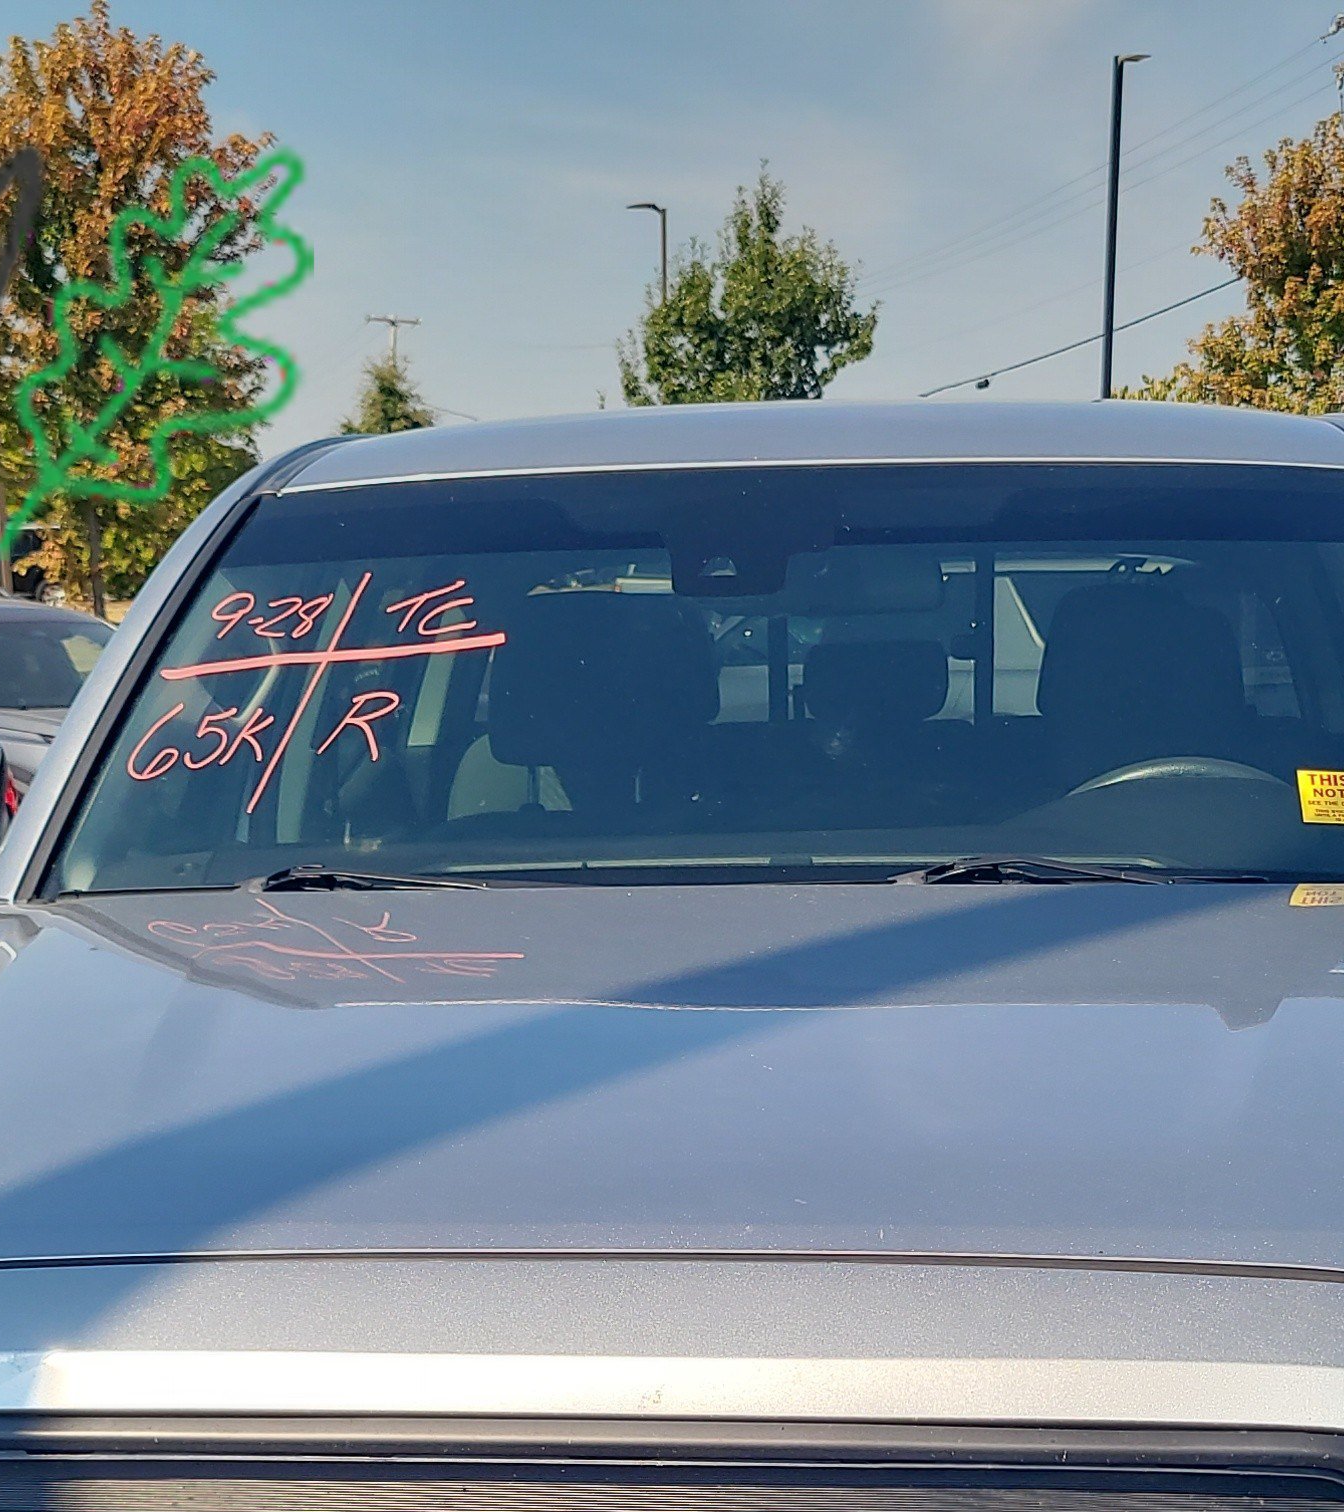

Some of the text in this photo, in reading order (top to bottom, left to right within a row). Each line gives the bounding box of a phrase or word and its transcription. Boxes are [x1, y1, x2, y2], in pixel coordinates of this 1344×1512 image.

[211, 579, 478, 640] 9-28 TC
[126, 690, 400, 780] 65K R
